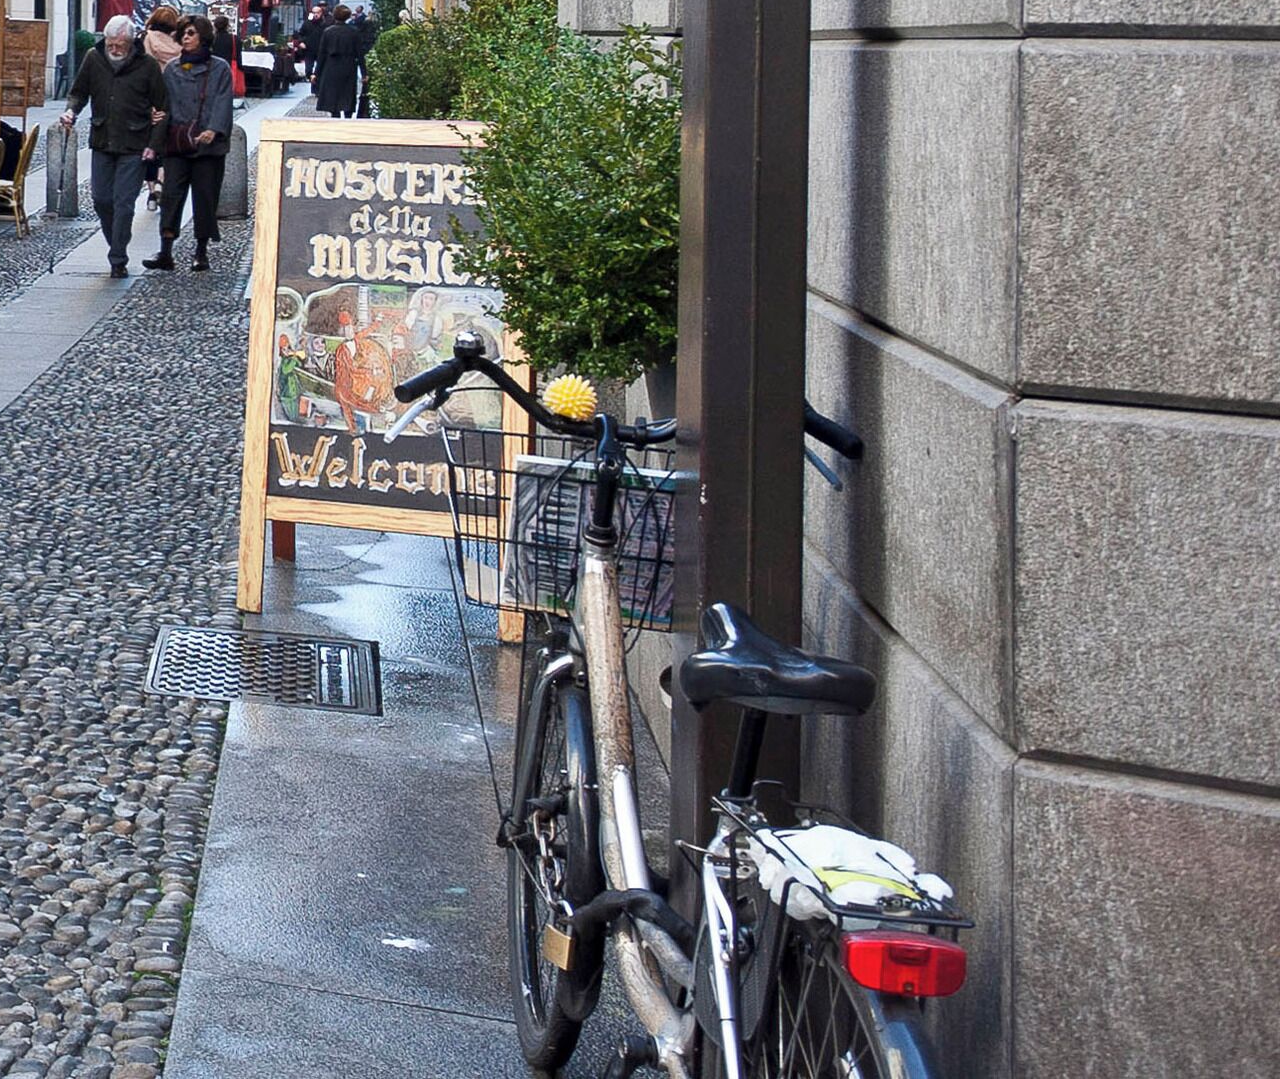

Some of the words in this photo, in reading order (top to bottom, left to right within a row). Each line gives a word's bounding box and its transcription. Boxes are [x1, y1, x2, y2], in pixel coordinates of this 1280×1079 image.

[349, 203, 432, 238] della
[307, 233, 486, 287] MUSIC
[270, 432, 497, 500] Welcome
